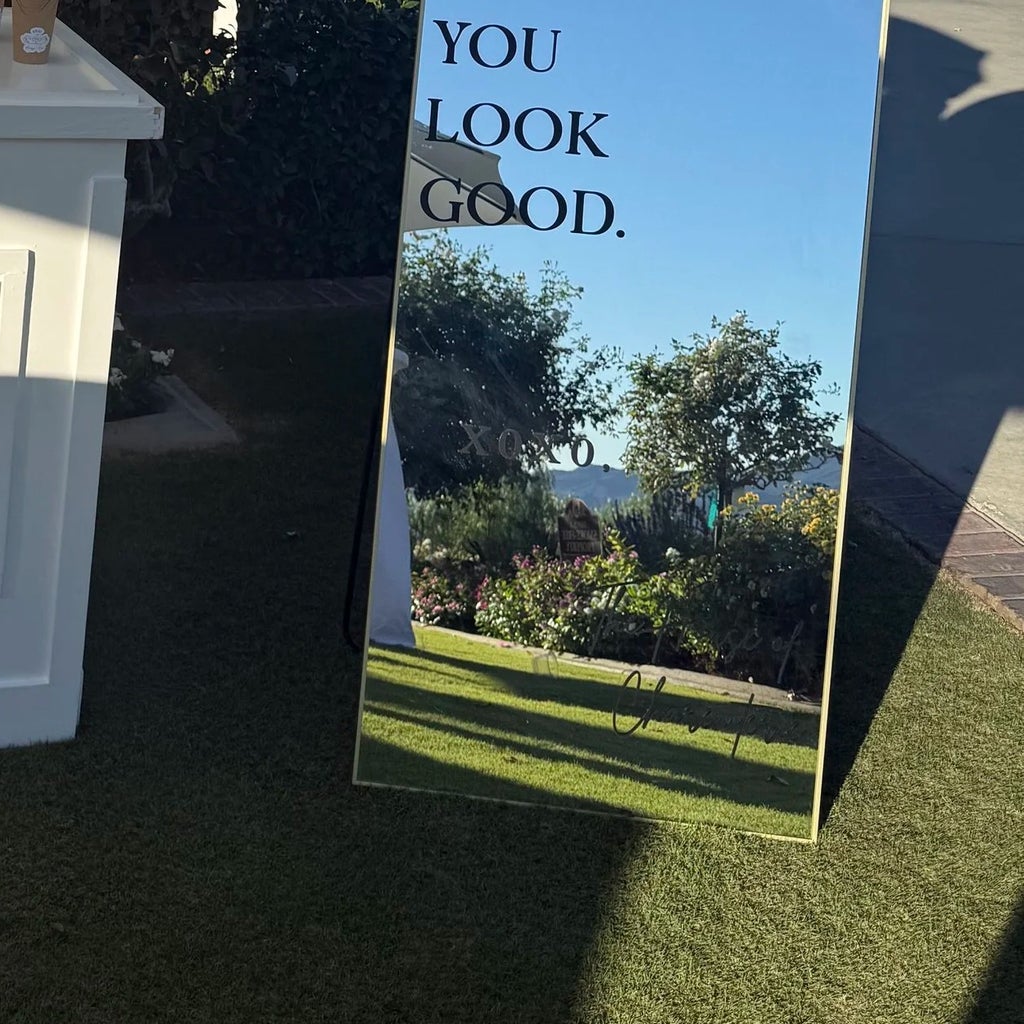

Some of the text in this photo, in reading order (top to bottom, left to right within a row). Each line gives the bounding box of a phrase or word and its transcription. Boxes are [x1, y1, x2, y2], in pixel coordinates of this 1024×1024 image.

[433, 20, 561, 72] YOU
[424, 98, 610, 158] LOOK
[419, 177, 626, 239] GOOD.
